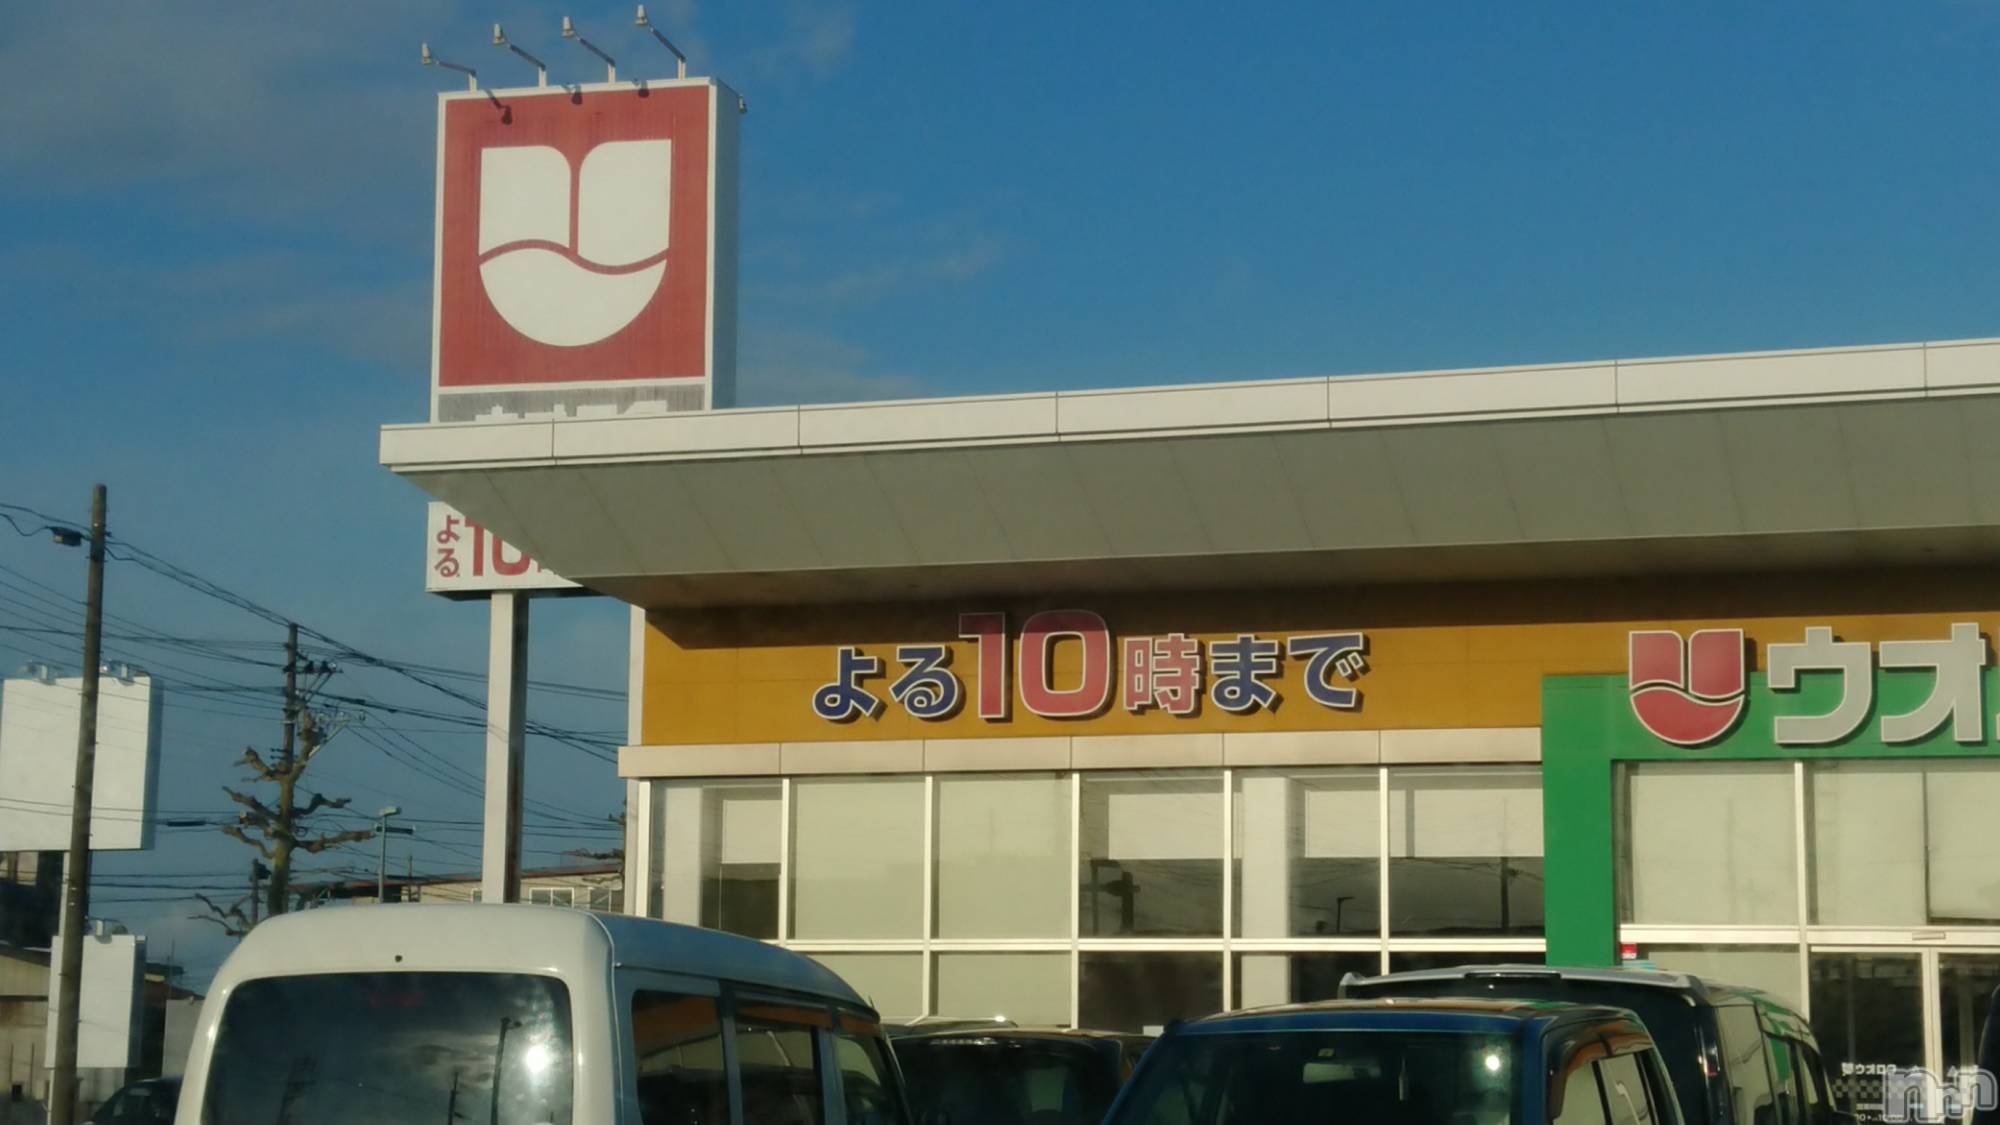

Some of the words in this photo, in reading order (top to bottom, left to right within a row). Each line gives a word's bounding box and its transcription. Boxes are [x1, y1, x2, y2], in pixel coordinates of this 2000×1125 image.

[465, 516, 542, 576] 10
[812, 609, 1366, 720] よる10時まで
[1767, 622, 2000, 744] ウオ
